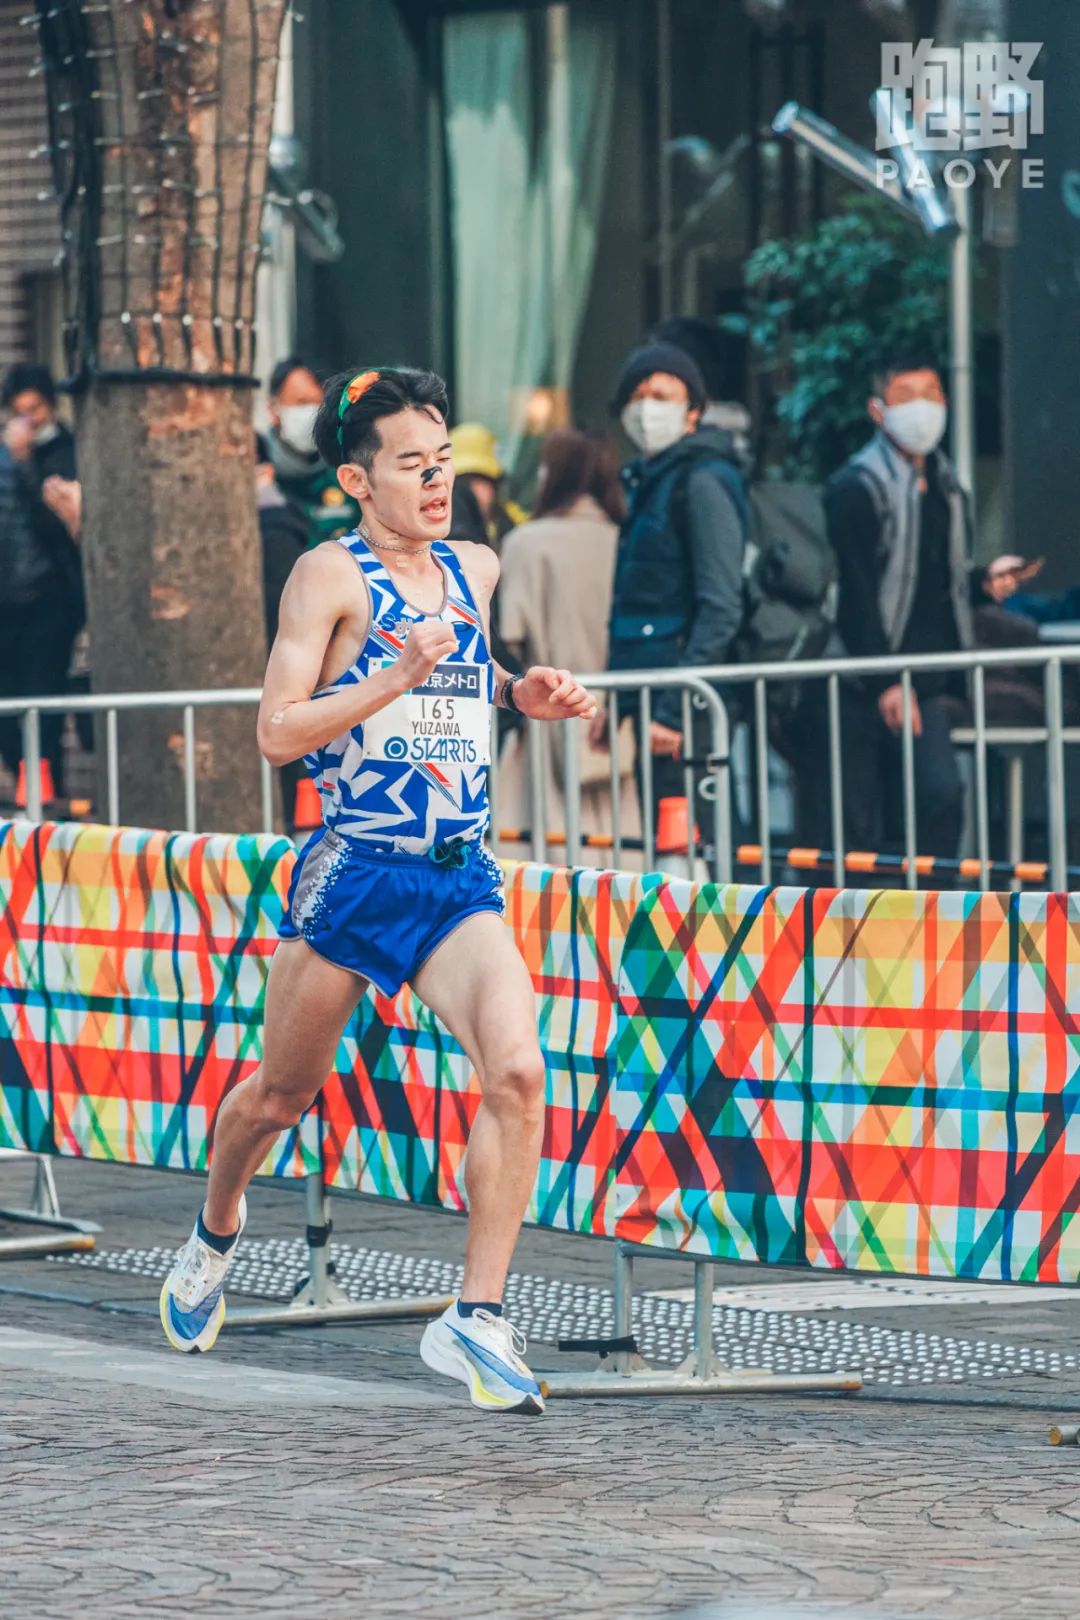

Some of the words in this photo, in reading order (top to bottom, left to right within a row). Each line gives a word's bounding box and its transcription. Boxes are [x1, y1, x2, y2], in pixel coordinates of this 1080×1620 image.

[421, 698, 455, 720] 165
[411, 721, 461, 737] YUZAWA
[410, 737, 477, 763] STARTS
